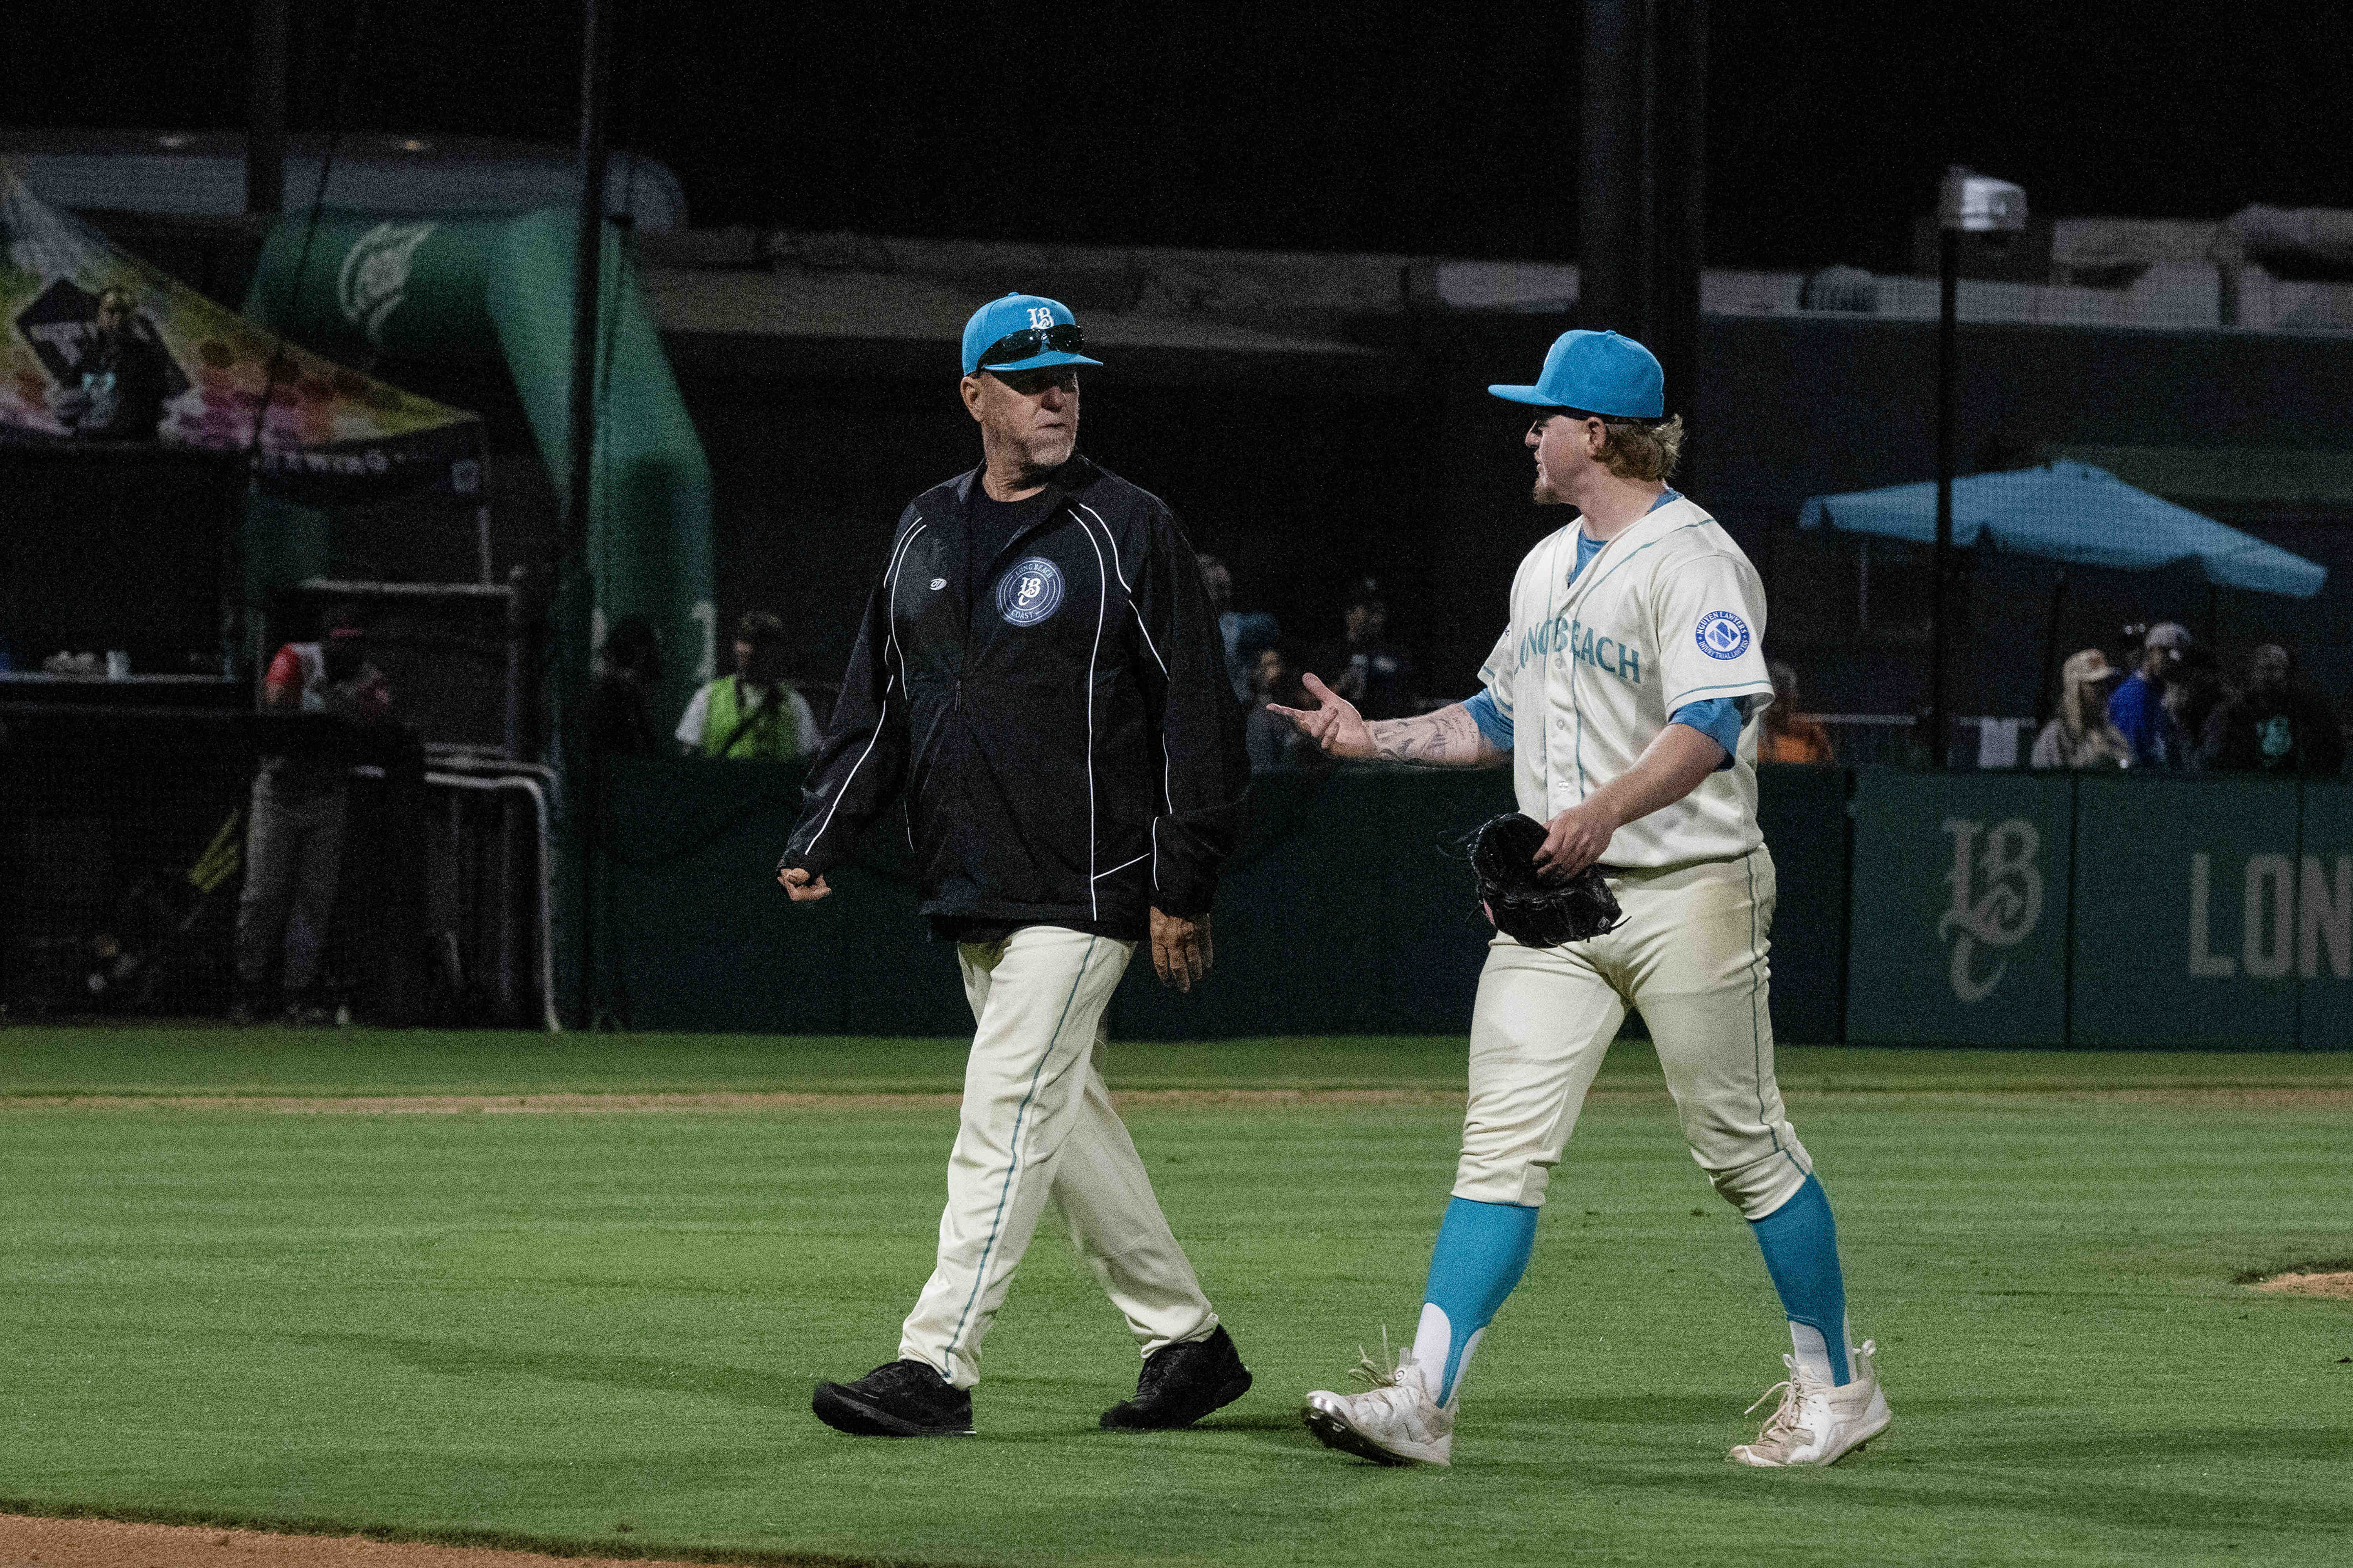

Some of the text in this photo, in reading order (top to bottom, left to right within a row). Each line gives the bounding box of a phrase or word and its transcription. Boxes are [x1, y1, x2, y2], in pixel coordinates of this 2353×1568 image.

[1034, 564, 1055, 578] BEACH
[1011, 610, 1033, 619] COAST
[1697, 611, 1747, 635] NGUYEN LAWYERS
[1554, 617, 1641, 684] BEACH
[1698, 640, 1716, 657] INJURY
[1715, 651, 1732, 660] TRIAL
